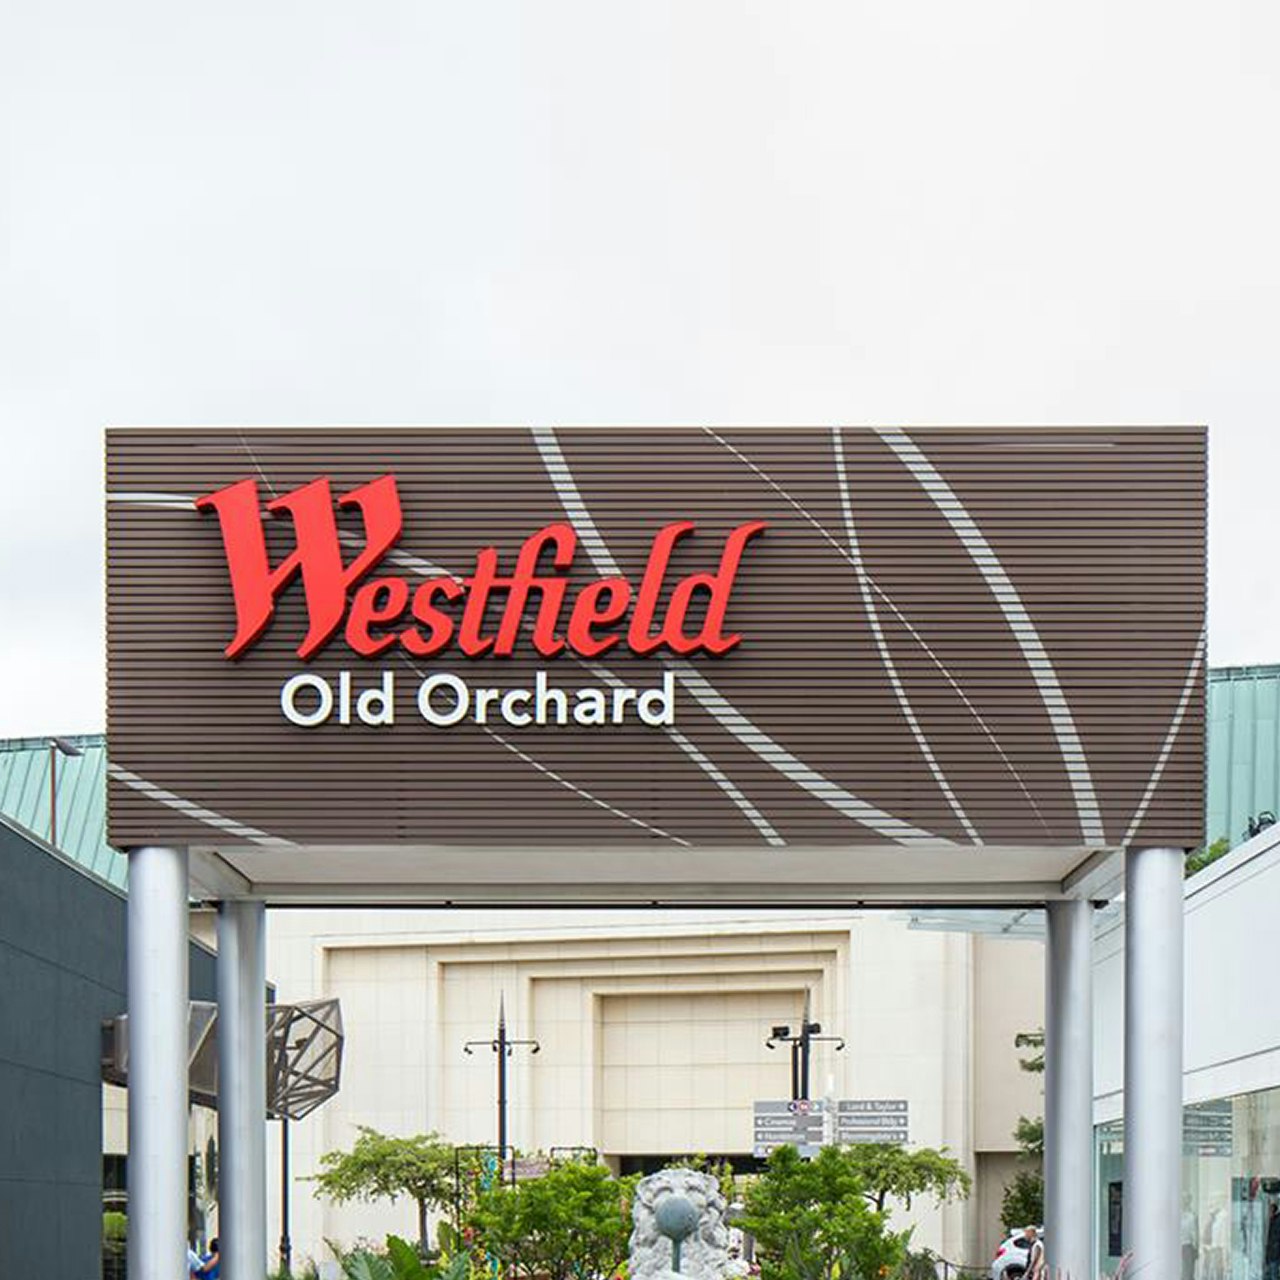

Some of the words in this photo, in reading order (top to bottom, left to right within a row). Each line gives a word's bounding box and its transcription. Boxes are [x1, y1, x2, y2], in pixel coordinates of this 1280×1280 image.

[195, 473, 768, 661] Westfield
[280, 671, 395, 726] Old
[418, 671, 675, 726] Orchard
